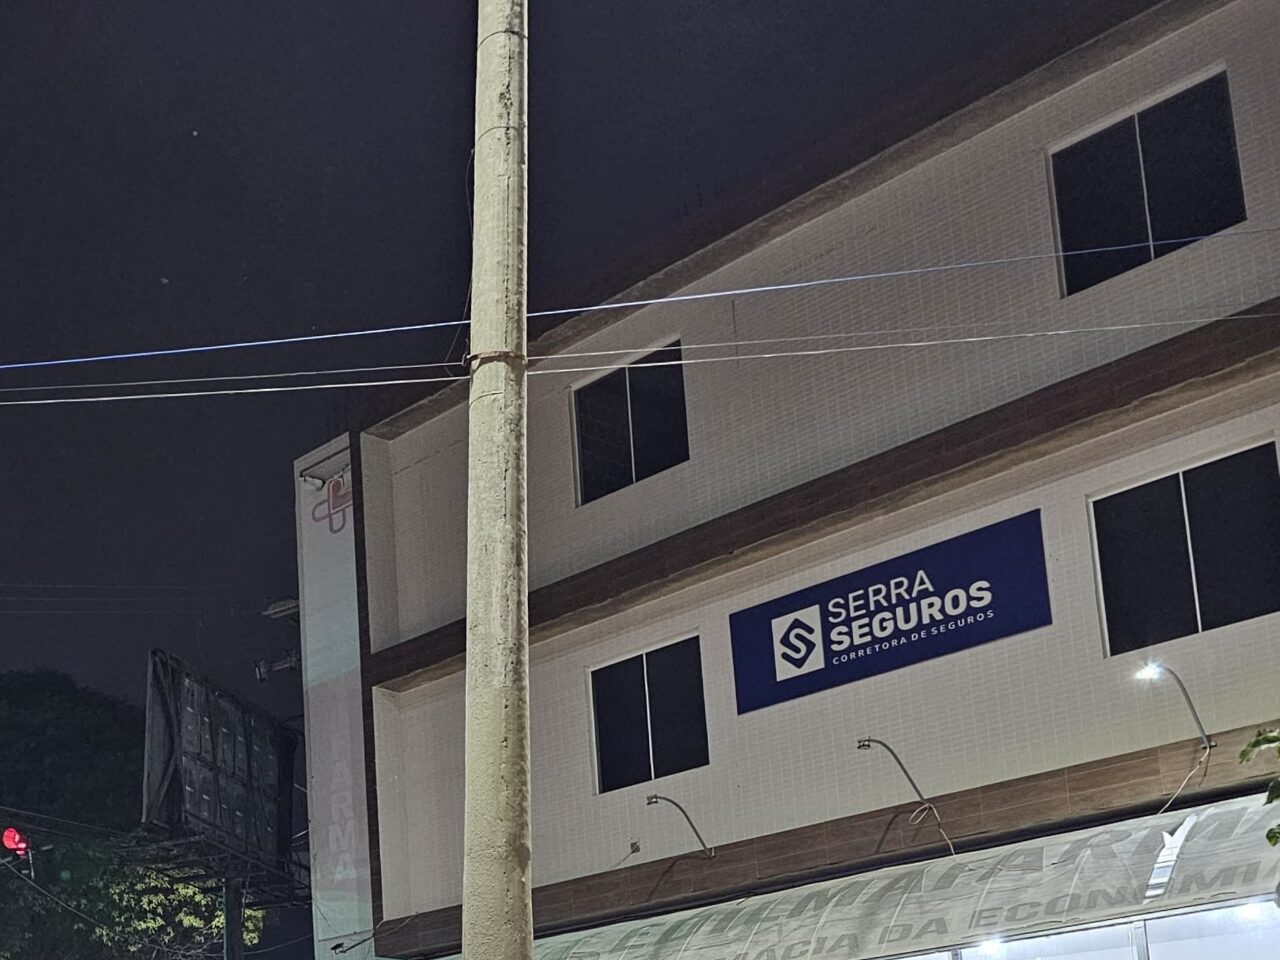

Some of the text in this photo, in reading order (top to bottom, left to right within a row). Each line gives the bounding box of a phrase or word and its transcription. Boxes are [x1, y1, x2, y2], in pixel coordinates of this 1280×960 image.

[827, 569, 935, 623] SERRA
[829, 580, 993, 652] SEGUROS
[832, 609, 995, 664] CORRETORA DE SEGUROS
[877, 918, 948, 945] DA
